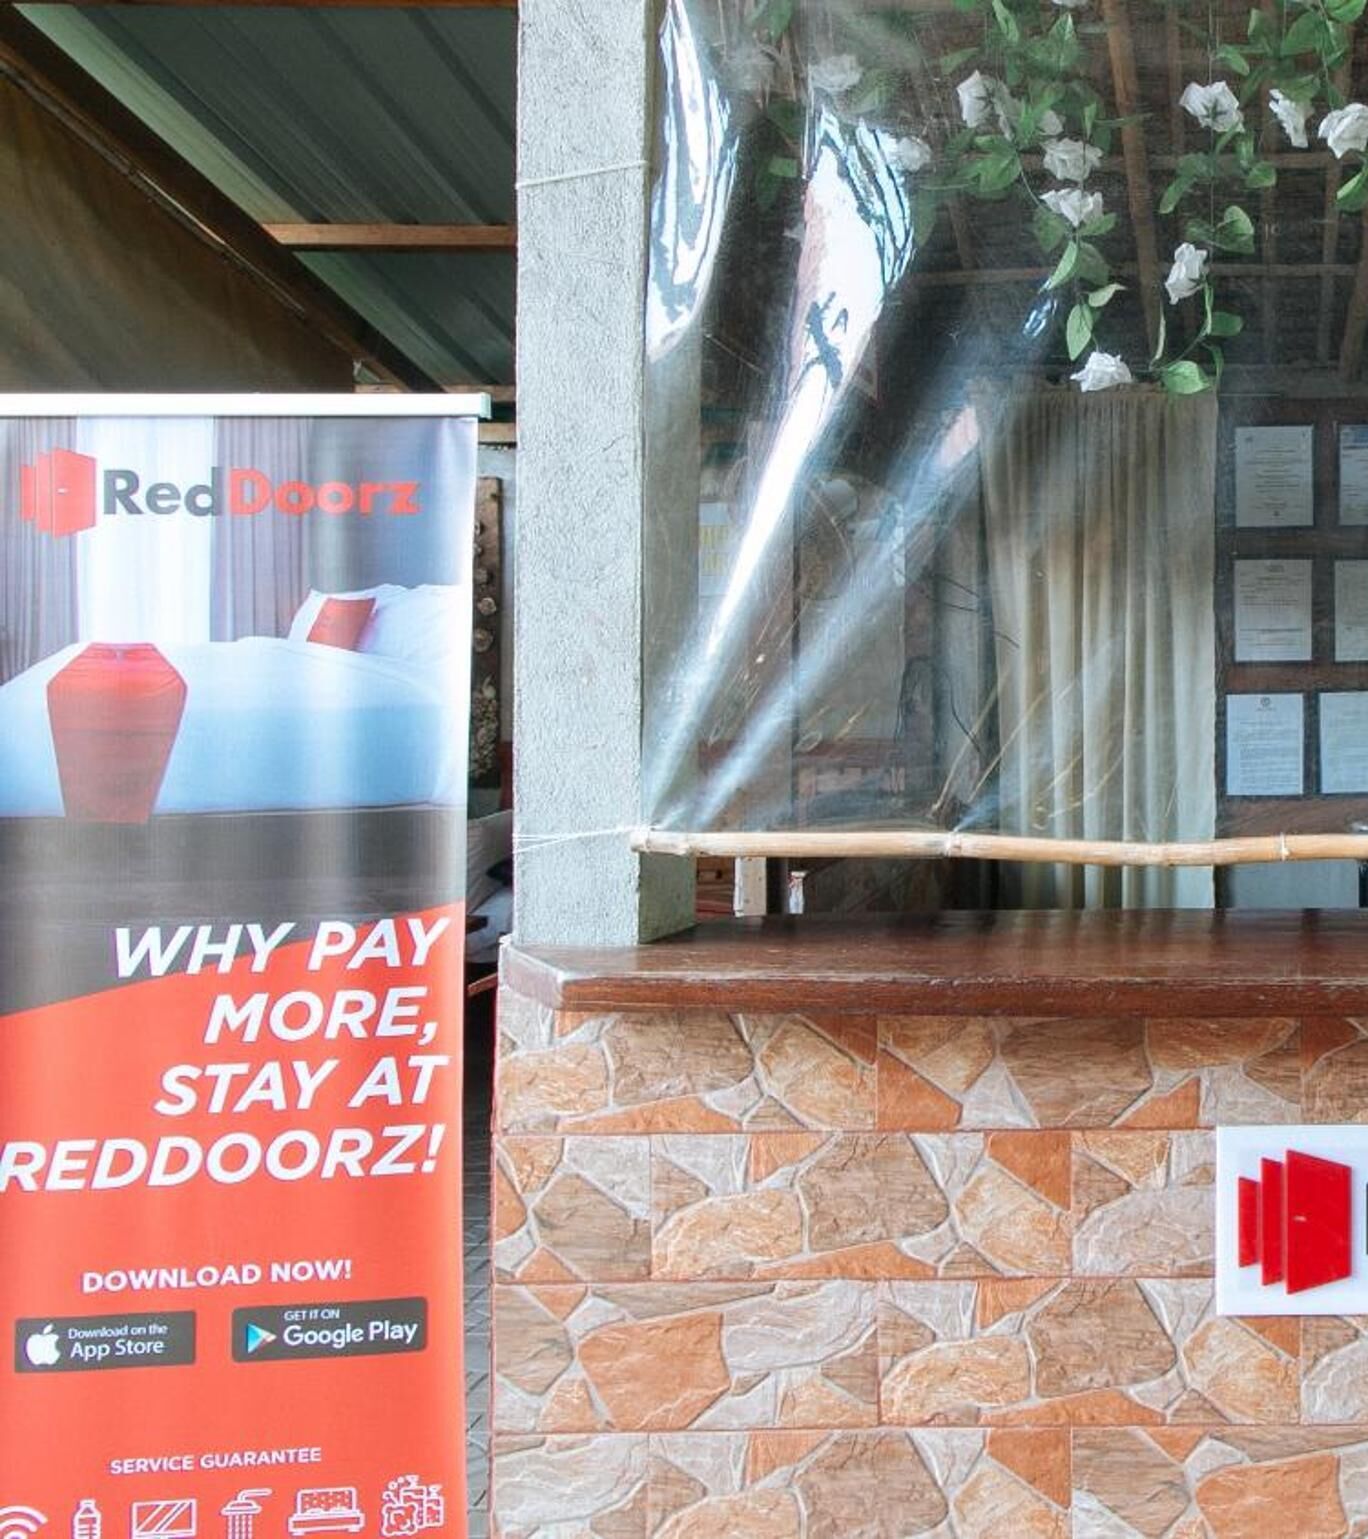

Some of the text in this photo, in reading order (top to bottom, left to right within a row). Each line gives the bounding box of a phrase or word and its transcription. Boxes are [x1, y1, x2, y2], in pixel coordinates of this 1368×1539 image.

[103, 466, 422, 517] RedDoorz
[115, 917, 450, 978] WHY PAY
[204, 986, 439, 1045] MORE,
[154, 1055, 450, 1116] STAY AT
[0, 1124, 446, 1193] REDDOORZ!
[81, 1259, 353, 1294] DOWNLOAD NOW!
[68, 1324, 169, 1340] Download on the
[284, 1309, 341, 1321] GET IT ON
[70, 1339, 165, 1361] App Store
[283, 1321, 418, 1349] Google Play
[110, 1447, 322, 1475] SERVICE GUARANTEE
